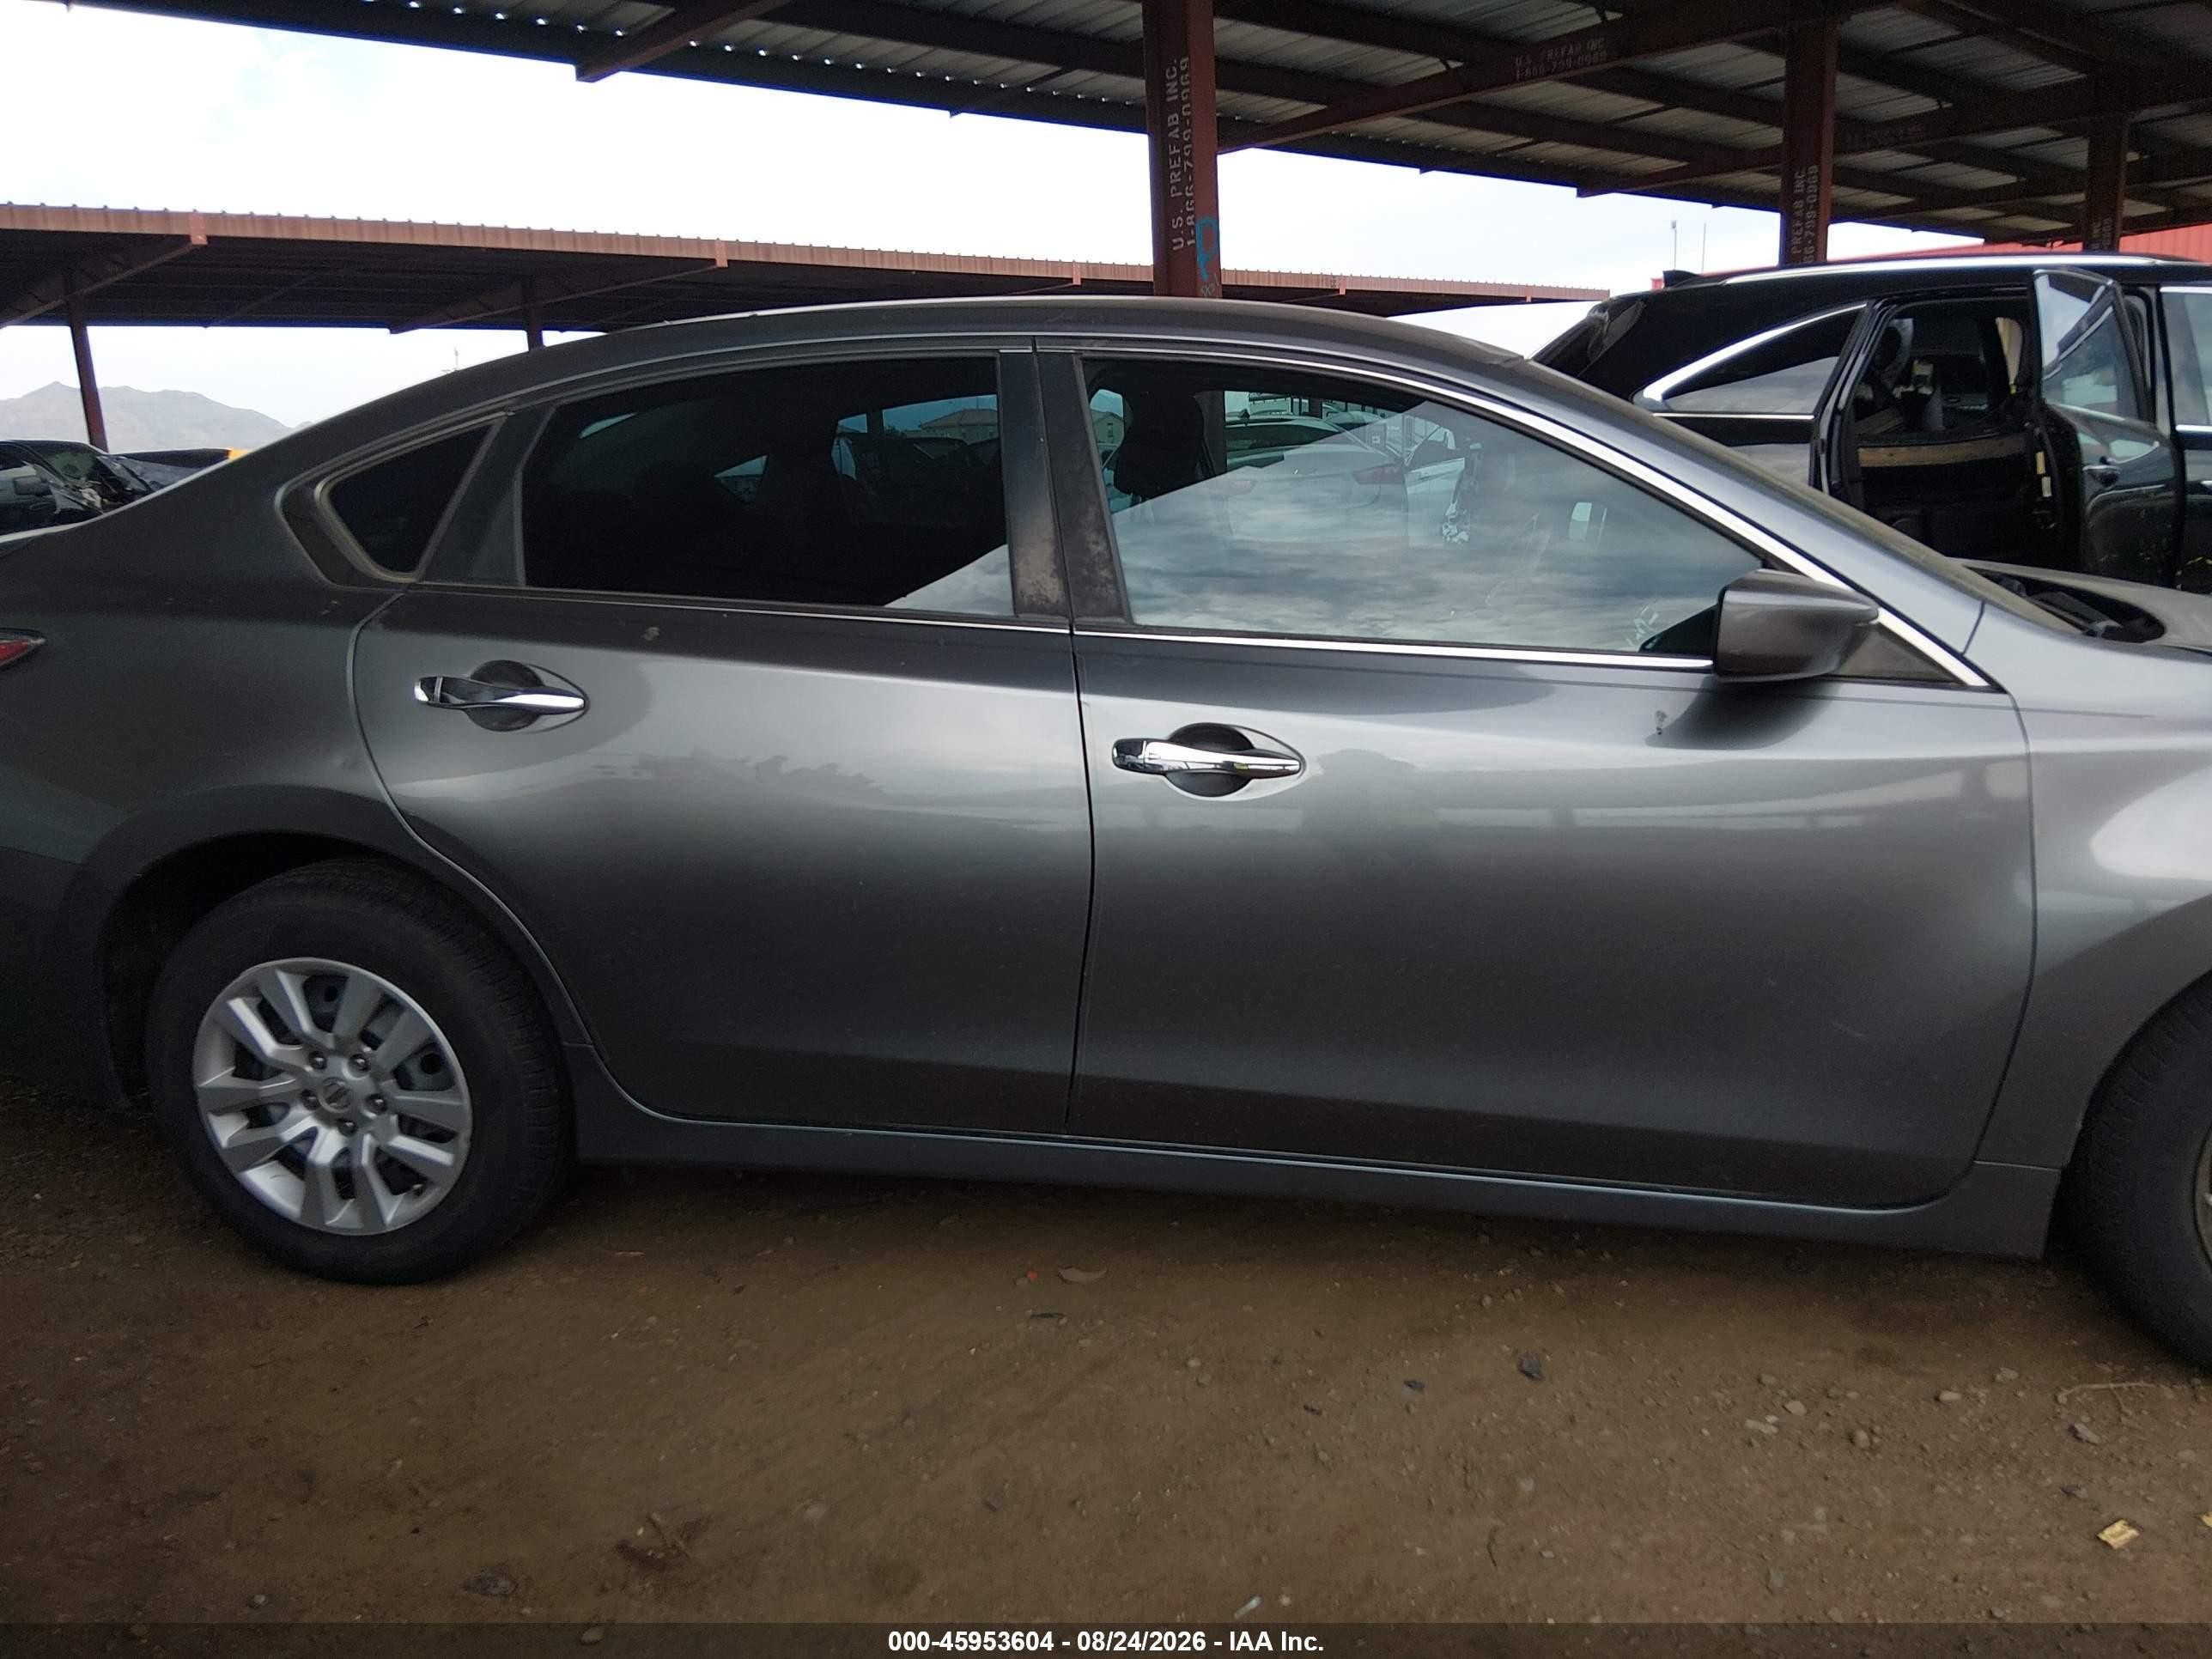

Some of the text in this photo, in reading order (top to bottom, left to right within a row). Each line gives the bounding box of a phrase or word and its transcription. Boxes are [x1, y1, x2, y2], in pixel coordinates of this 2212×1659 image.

[1165, 58, 1184, 251] U.S. PREFAB INC.
[1791, 198, 1804, 254] PREFAB
